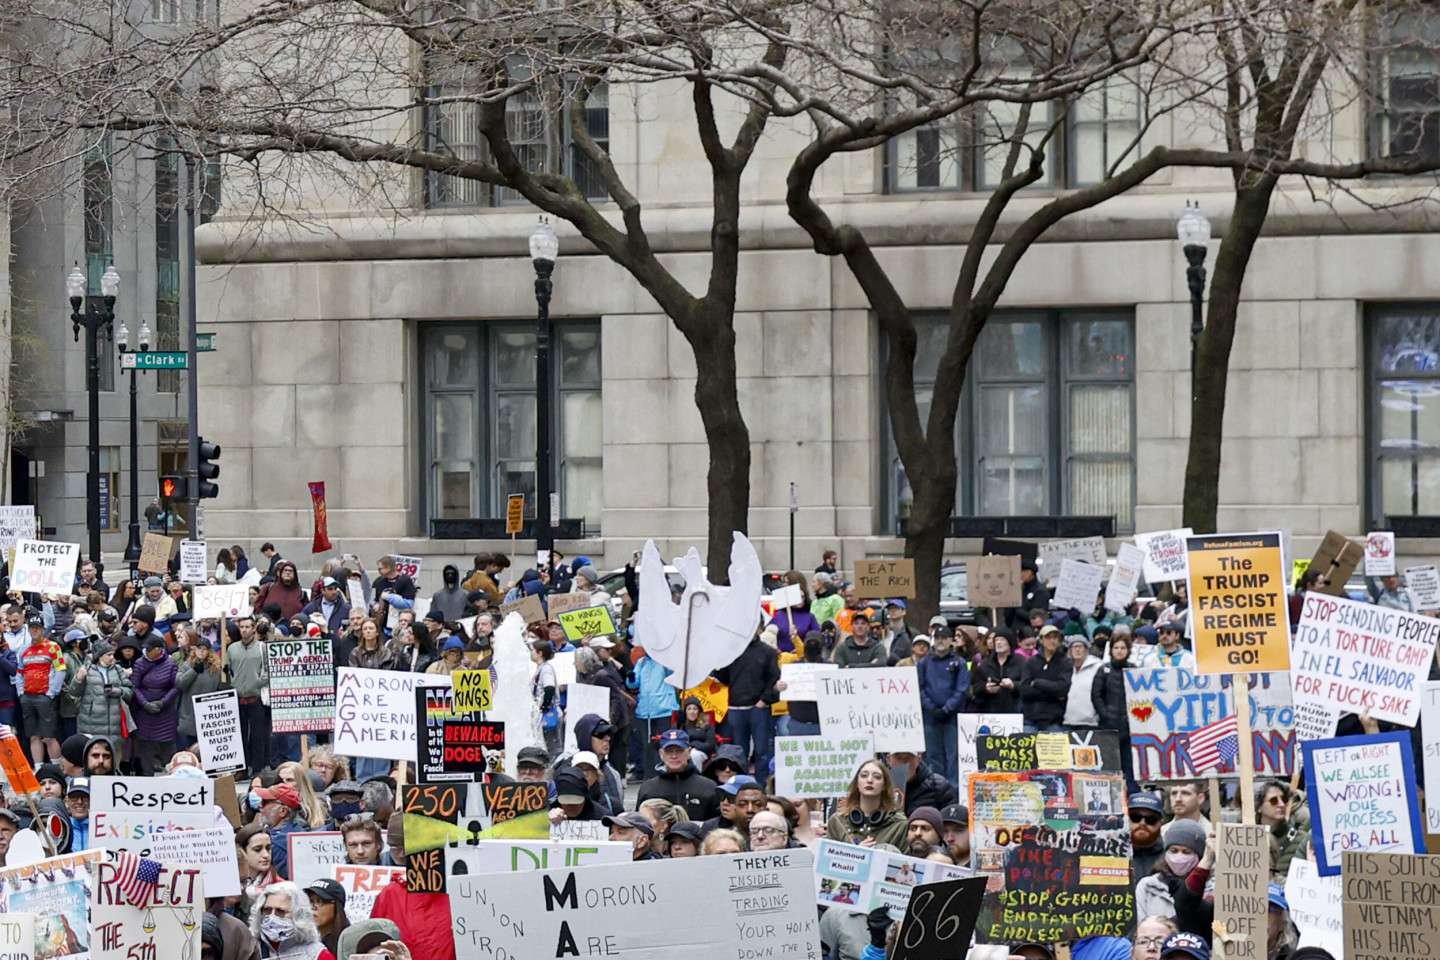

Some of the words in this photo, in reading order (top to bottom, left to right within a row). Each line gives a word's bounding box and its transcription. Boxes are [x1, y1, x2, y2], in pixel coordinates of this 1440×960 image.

[145, 355, 175, 364] Clark
[23, 543, 72, 555] PROTECT
[1063, 540, 1080, 550] THE
[37, 558, 56, 566] THE
[868, 563, 897, 574] EAT
[1218, 556, 1252, 570] The
[860, 576, 880, 586] THE
[888, 576, 910, 586] RICH
[1203, 574, 1270, 590] TRUMP
[1198, 593, 1277, 610] FASCIST
[578, 611, 603, 623] KINGS
[1204, 613, 1277, 629] REGIME
[1216, 632, 1267, 648] MUST
[1300, 624, 1321, 643] TO
[1321, 631, 1332, 647] A
[269, 643, 302, 657] STOP
[306, 641, 329, 654] THE
[1228, 650, 1259, 664] GO!
[460, 673, 482, 686] NO
[1299, 651, 1320, 671] IN
[1325, 655, 1342, 674] EL
[1352, 660, 1416, 692] SALVADOR
[821, 676, 856, 696] TIME
[876, 678, 910, 694] TAX
[1124, 670, 1166, 692] WE
[454, 688, 489, 708] KINGS
[1378, 696, 1412, 716] SAKE
[208, 703, 226, 711] THE
[203, 710, 233, 721] TRUMP
[200, 718, 236, 730] FASCIST
[203, 728, 236, 738] REGIME
[208, 735, 233, 744] MUST
[444, 725, 493, 742] BEWARE
[780, 739, 799, 752] WE
[841, 738, 870, 751] NOT
[444, 747, 483, 763] DOGE
[807, 754, 856, 766] SILENT
[999, 749, 1035, 761] MASS
[793, 767, 854, 781] AGAINST
[112, 782, 208, 812] Respect
[405, 786, 459, 814] 250
[484, 785, 547, 811] YEARS
[1224, 826, 1264, 845] KEEP
[1368, 830, 1400, 847] ALL
[410, 850, 440, 870] WE
[733, 854, 790, 870] THEY'RE
[831, 861, 855, 873] Khalil
[1223, 849, 1261, 869] YOUR
[1347, 854, 1380, 875] HIS
[729, 873, 780, 886] INSIDER
[1221, 872, 1257, 890] TINY
[732, 894, 789, 909] TRADING
[1055, 891, 1134, 906] GENOCIDE
[1221, 897, 1265, 916] HANDS
[904, 889, 959, 950] 86
[0, 921, 22, 945] TO
[95, 922, 124, 951] THE
[738, 947, 773, 960] DOWN
